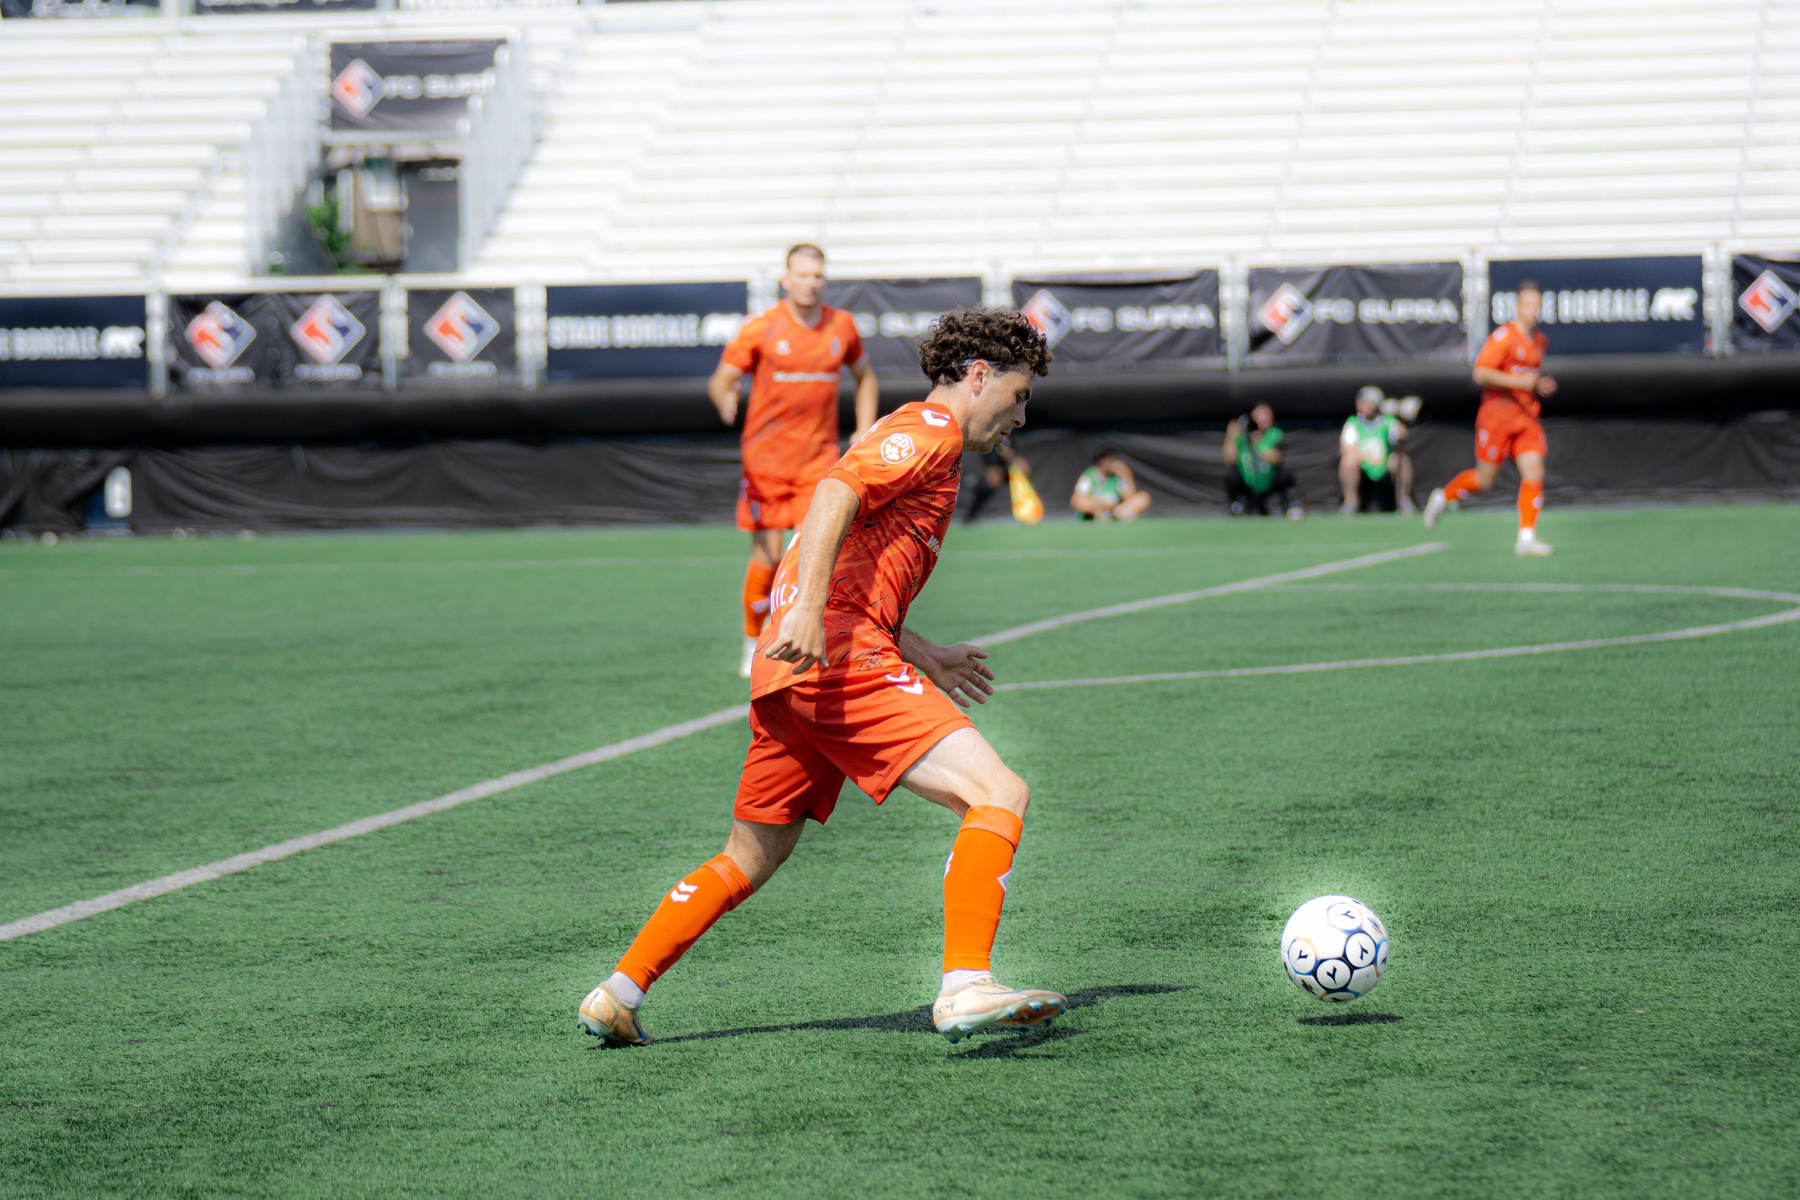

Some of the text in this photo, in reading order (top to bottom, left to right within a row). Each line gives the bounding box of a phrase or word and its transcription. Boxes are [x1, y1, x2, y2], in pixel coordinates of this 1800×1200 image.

[1072, 304, 1216, 333] FC SUPRA
[1313, 298, 1459, 324] FC SUPRA
[1492, 291, 1557, 324] STE
[548, 316, 610, 349] STADE
[855, 311, 940, 338] C SUP
